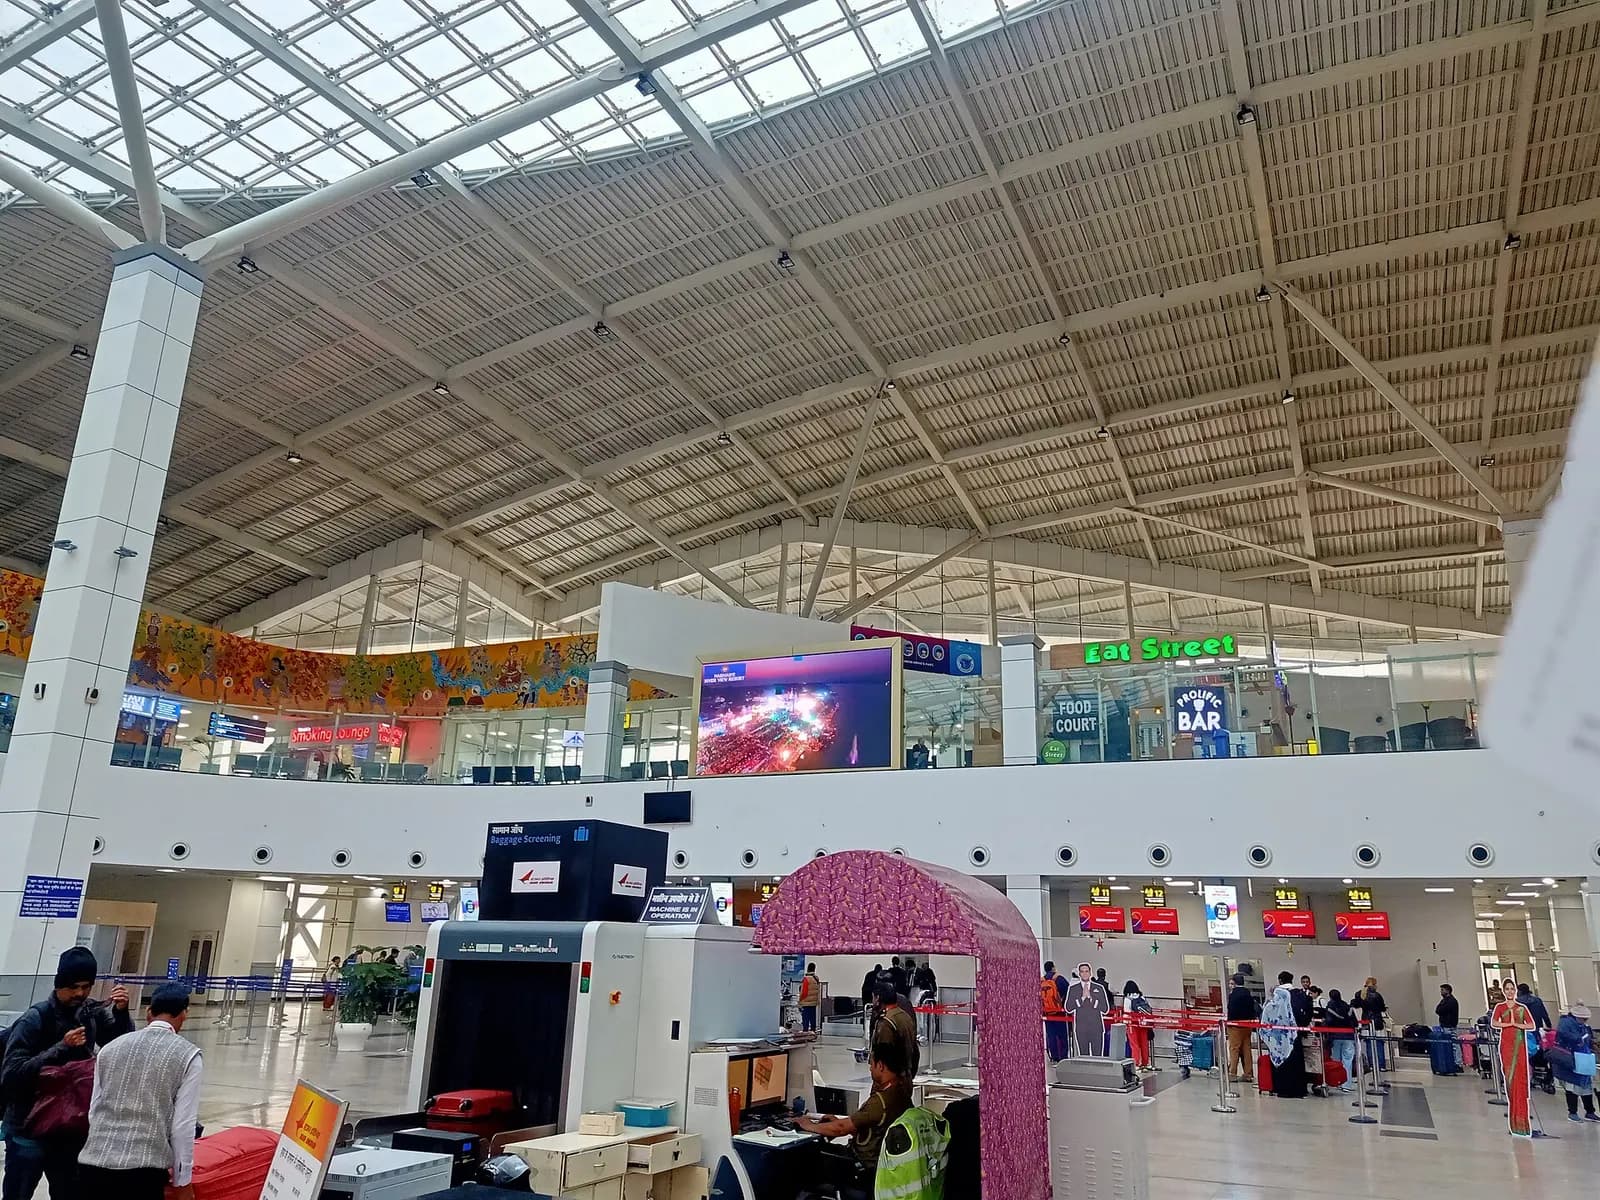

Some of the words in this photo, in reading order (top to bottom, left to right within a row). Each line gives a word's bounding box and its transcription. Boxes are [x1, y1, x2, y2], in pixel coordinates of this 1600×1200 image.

[1085, 642, 1130, 664] Eat
[1141, 634, 1234, 660] Street
[1176, 689, 1222, 708] PROLIFIC
[1059, 700, 1092, 716] FOOD
[1056, 716, 1097, 733] COURT
[1178, 712, 1222, 731] BAR
[292, 728, 332, 743] Smoking
[378, 723, 403, 738] Smoing
[492, 826, 510, 834] सामान
[490, 836, 522, 846] Baggage
[524, 834, 561, 844] Screening
